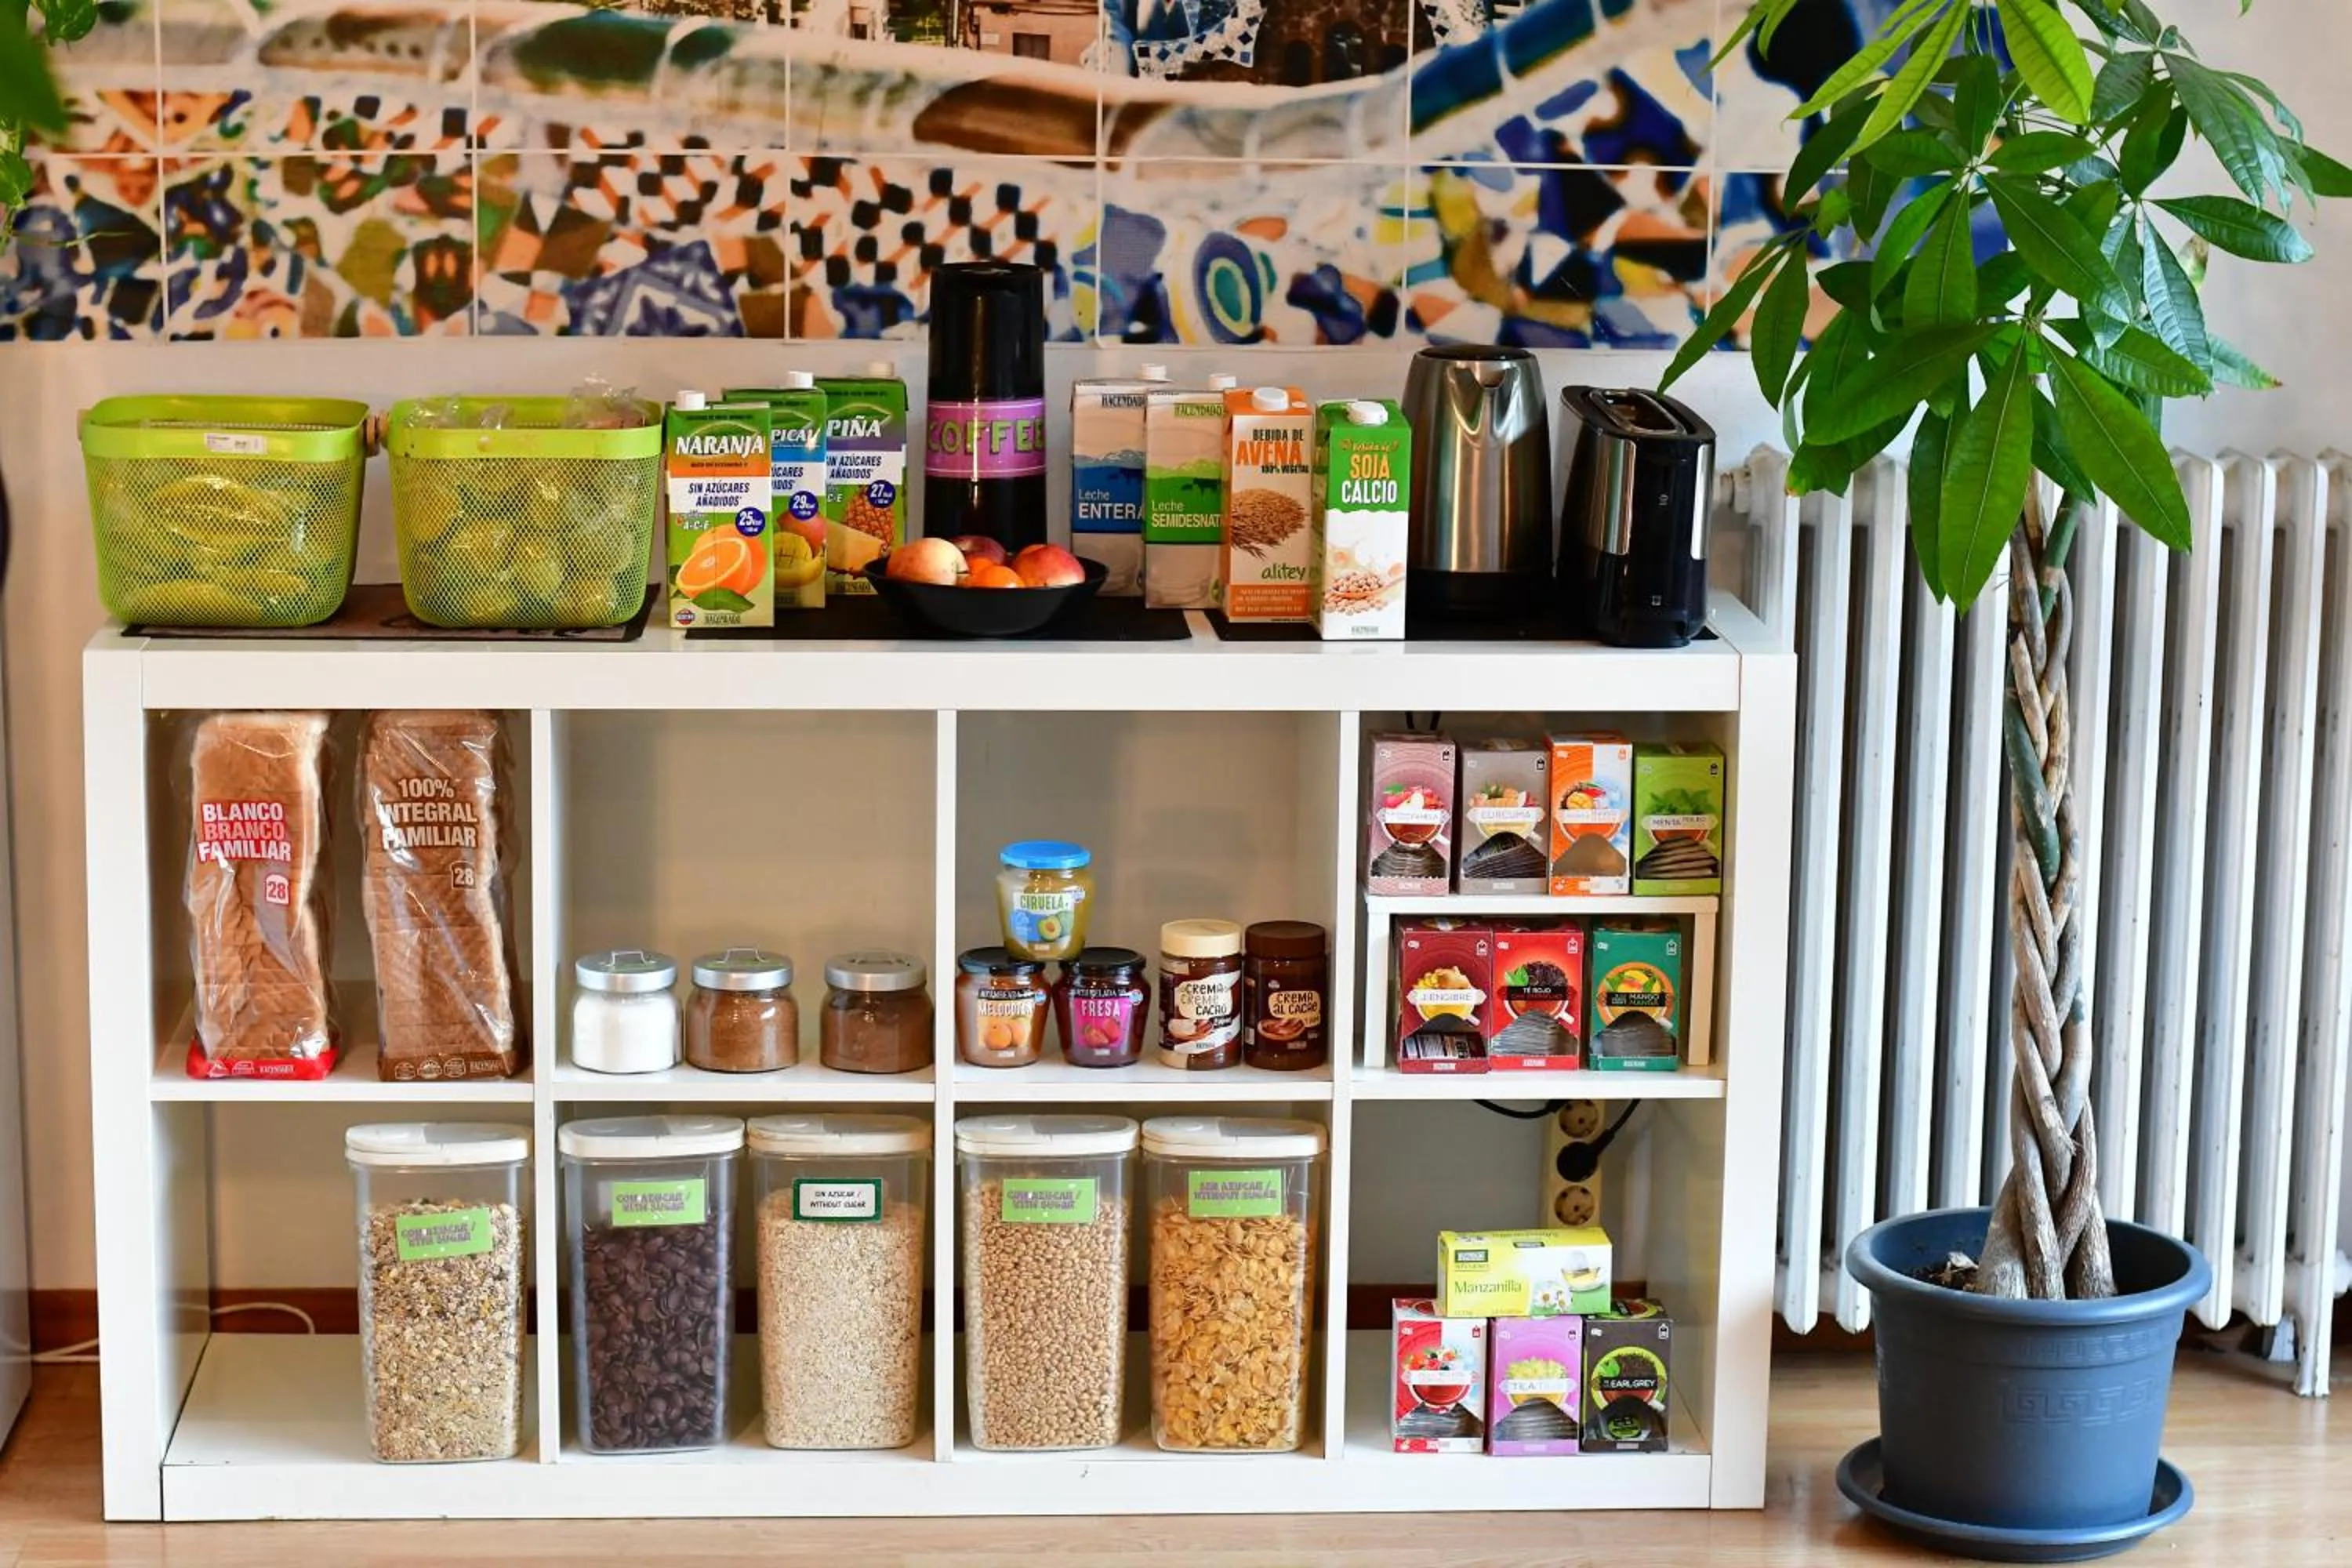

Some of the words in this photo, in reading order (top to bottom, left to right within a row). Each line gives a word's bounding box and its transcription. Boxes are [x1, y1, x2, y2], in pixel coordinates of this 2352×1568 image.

[1102, 394, 1148, 407] HACENDAD
[826, 416, 882, 437] PIÑA
[676, 435, 766, 459] NARANJA
[1236, 441, 1302, 466] AVENA
[688, 482, 702, 494] SIN
[705, 479, 750, 494] AZÚCARES
[869, 484, 885, 498] 27
[1078, 488, 1110, 501] Leche
[793, 495, 807, 509] 29
[1152, 500, 1185, 512] Leche
[739, 511, 753, 526] 25
[1152, 514, 1221, 528] SEMIDESNAT
[1261, 562, 1305, 580] alitey
[398, 778, 455, 799] 100%
[201, 802, 283, 822] BLANCO
[205, 821, 285, 840] BRANCO
[383, 826, 477, 849] FAMILIAR
[198, 840, 292, 861] FAMILIAR
[455, 867, 474, 886] 28
[267, 880, 285, 899] 28
[1020, 895, 1064, 910] CIRUELA
[1080, 999, 1121, 1017] FRESA
[1454, 1279, 1523, 1294] Manzanilla
[1632, 1379, 1656, 1388] GREY
